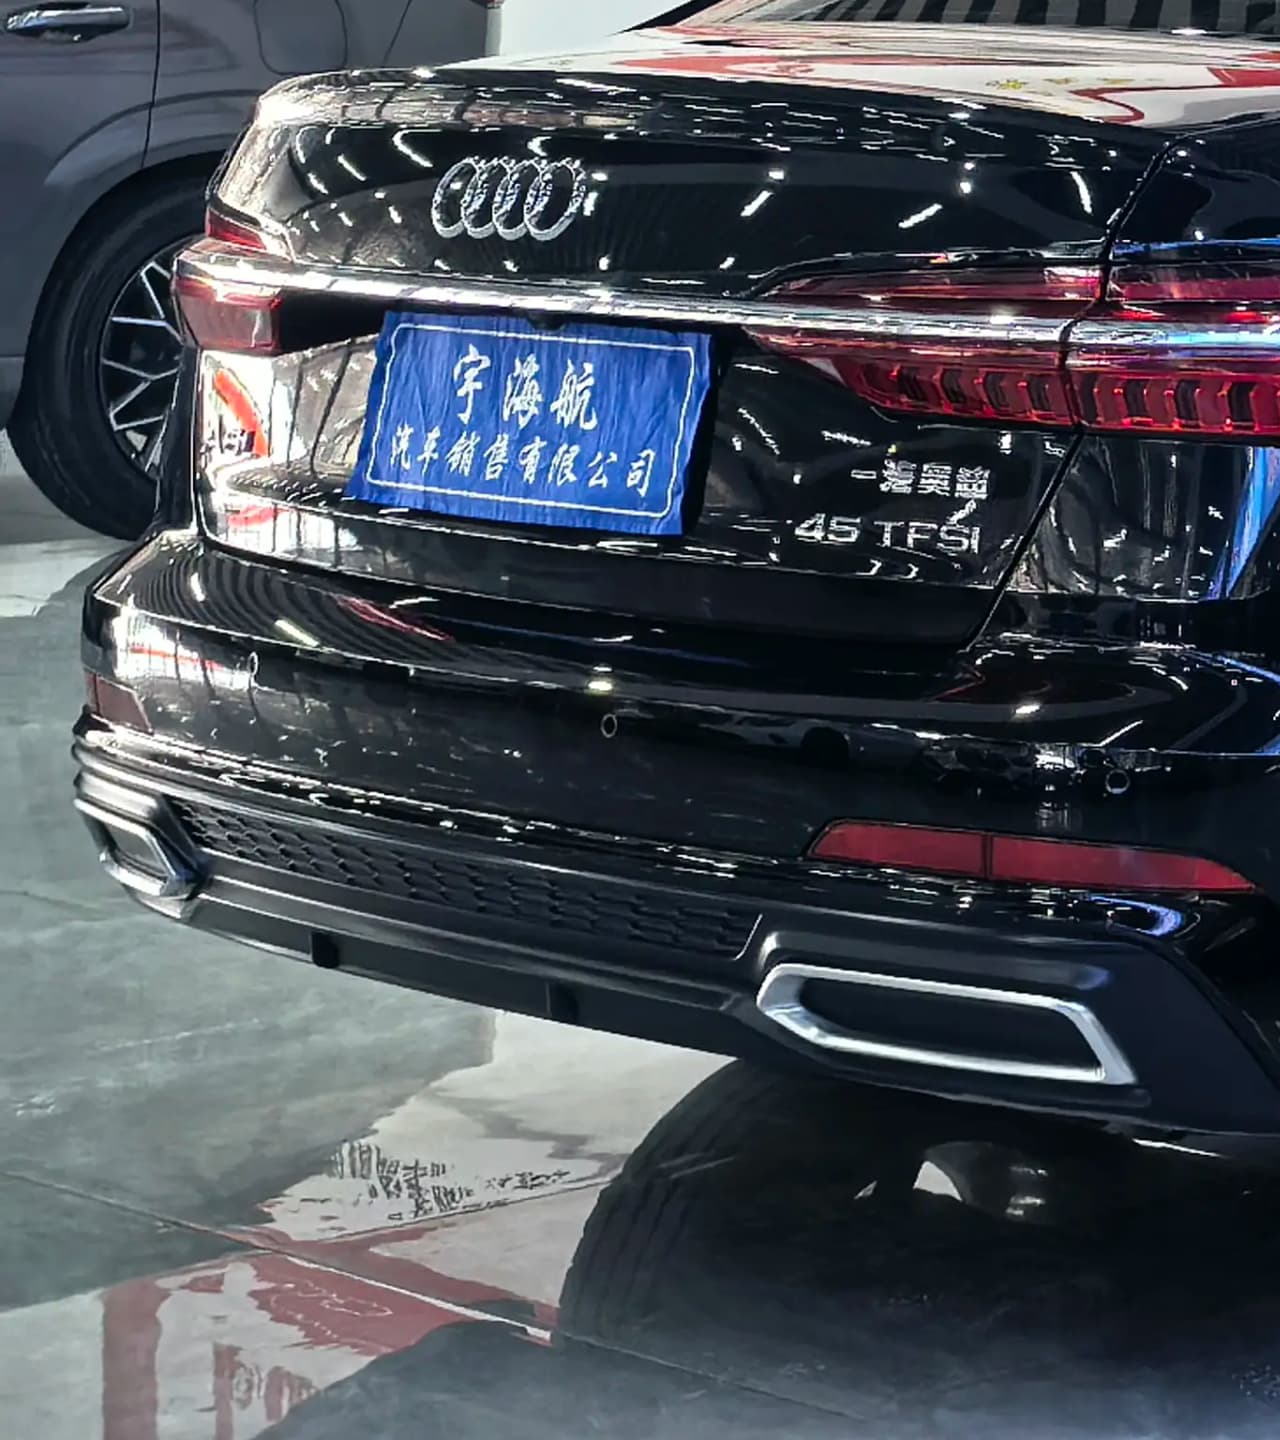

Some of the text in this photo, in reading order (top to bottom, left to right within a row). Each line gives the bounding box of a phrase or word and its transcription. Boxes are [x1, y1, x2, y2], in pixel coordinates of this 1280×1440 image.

[452, 344, 598, 431] 宇海航
[390, 416, 656, 498] 汽车销售有限公司
[795, 513, 981, 554] 45 TFSI
